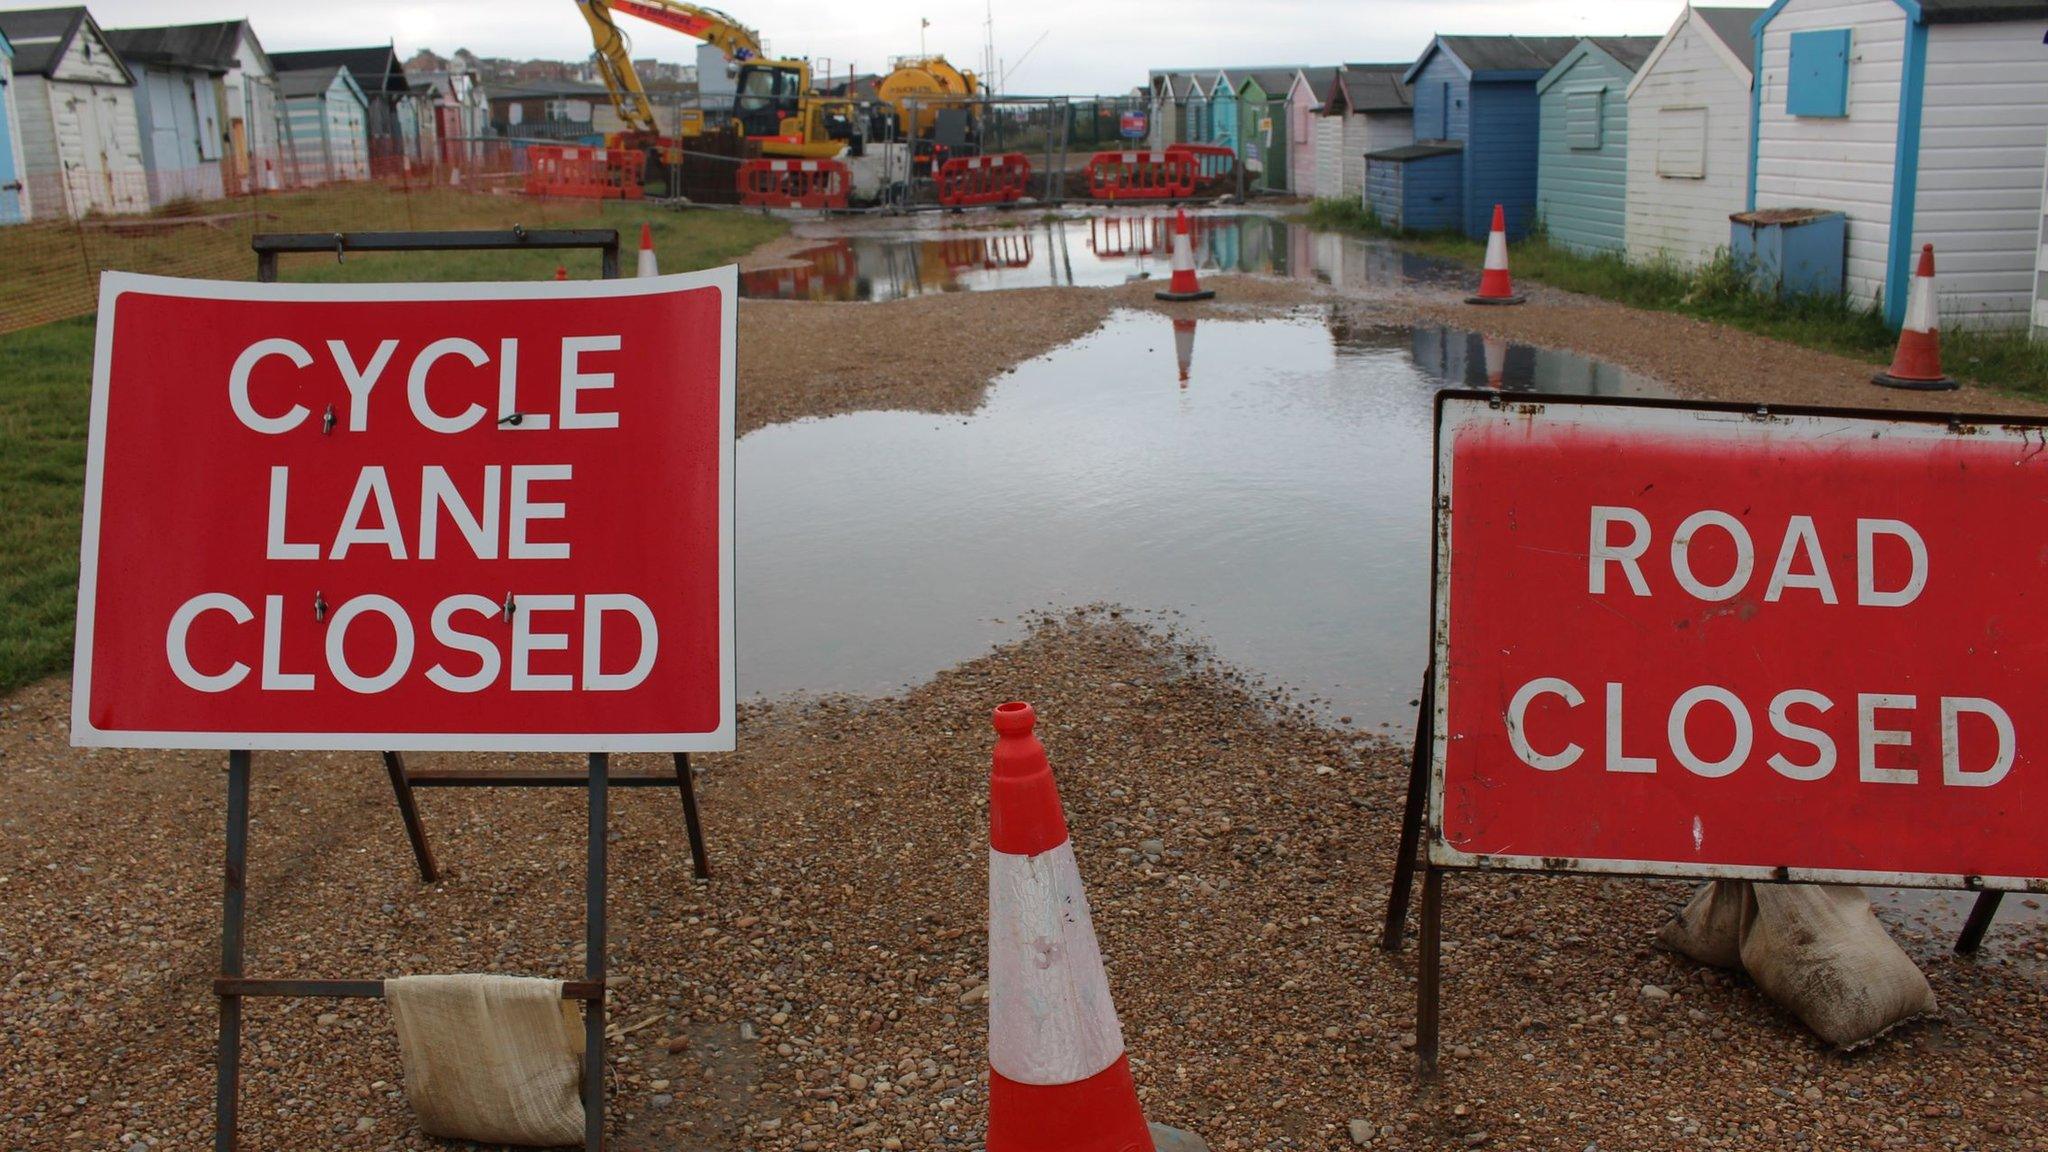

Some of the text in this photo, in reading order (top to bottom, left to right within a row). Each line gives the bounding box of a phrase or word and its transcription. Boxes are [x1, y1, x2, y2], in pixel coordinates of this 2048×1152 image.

[229, 335, 621, 434] CYCLE
[267, 465, 572, 559] LANE
[1589, 506, 1928, 606] ROAD
[167, 593, 658, 693] CLOSED
[1507, 678, 2015, 786] CLOSED
